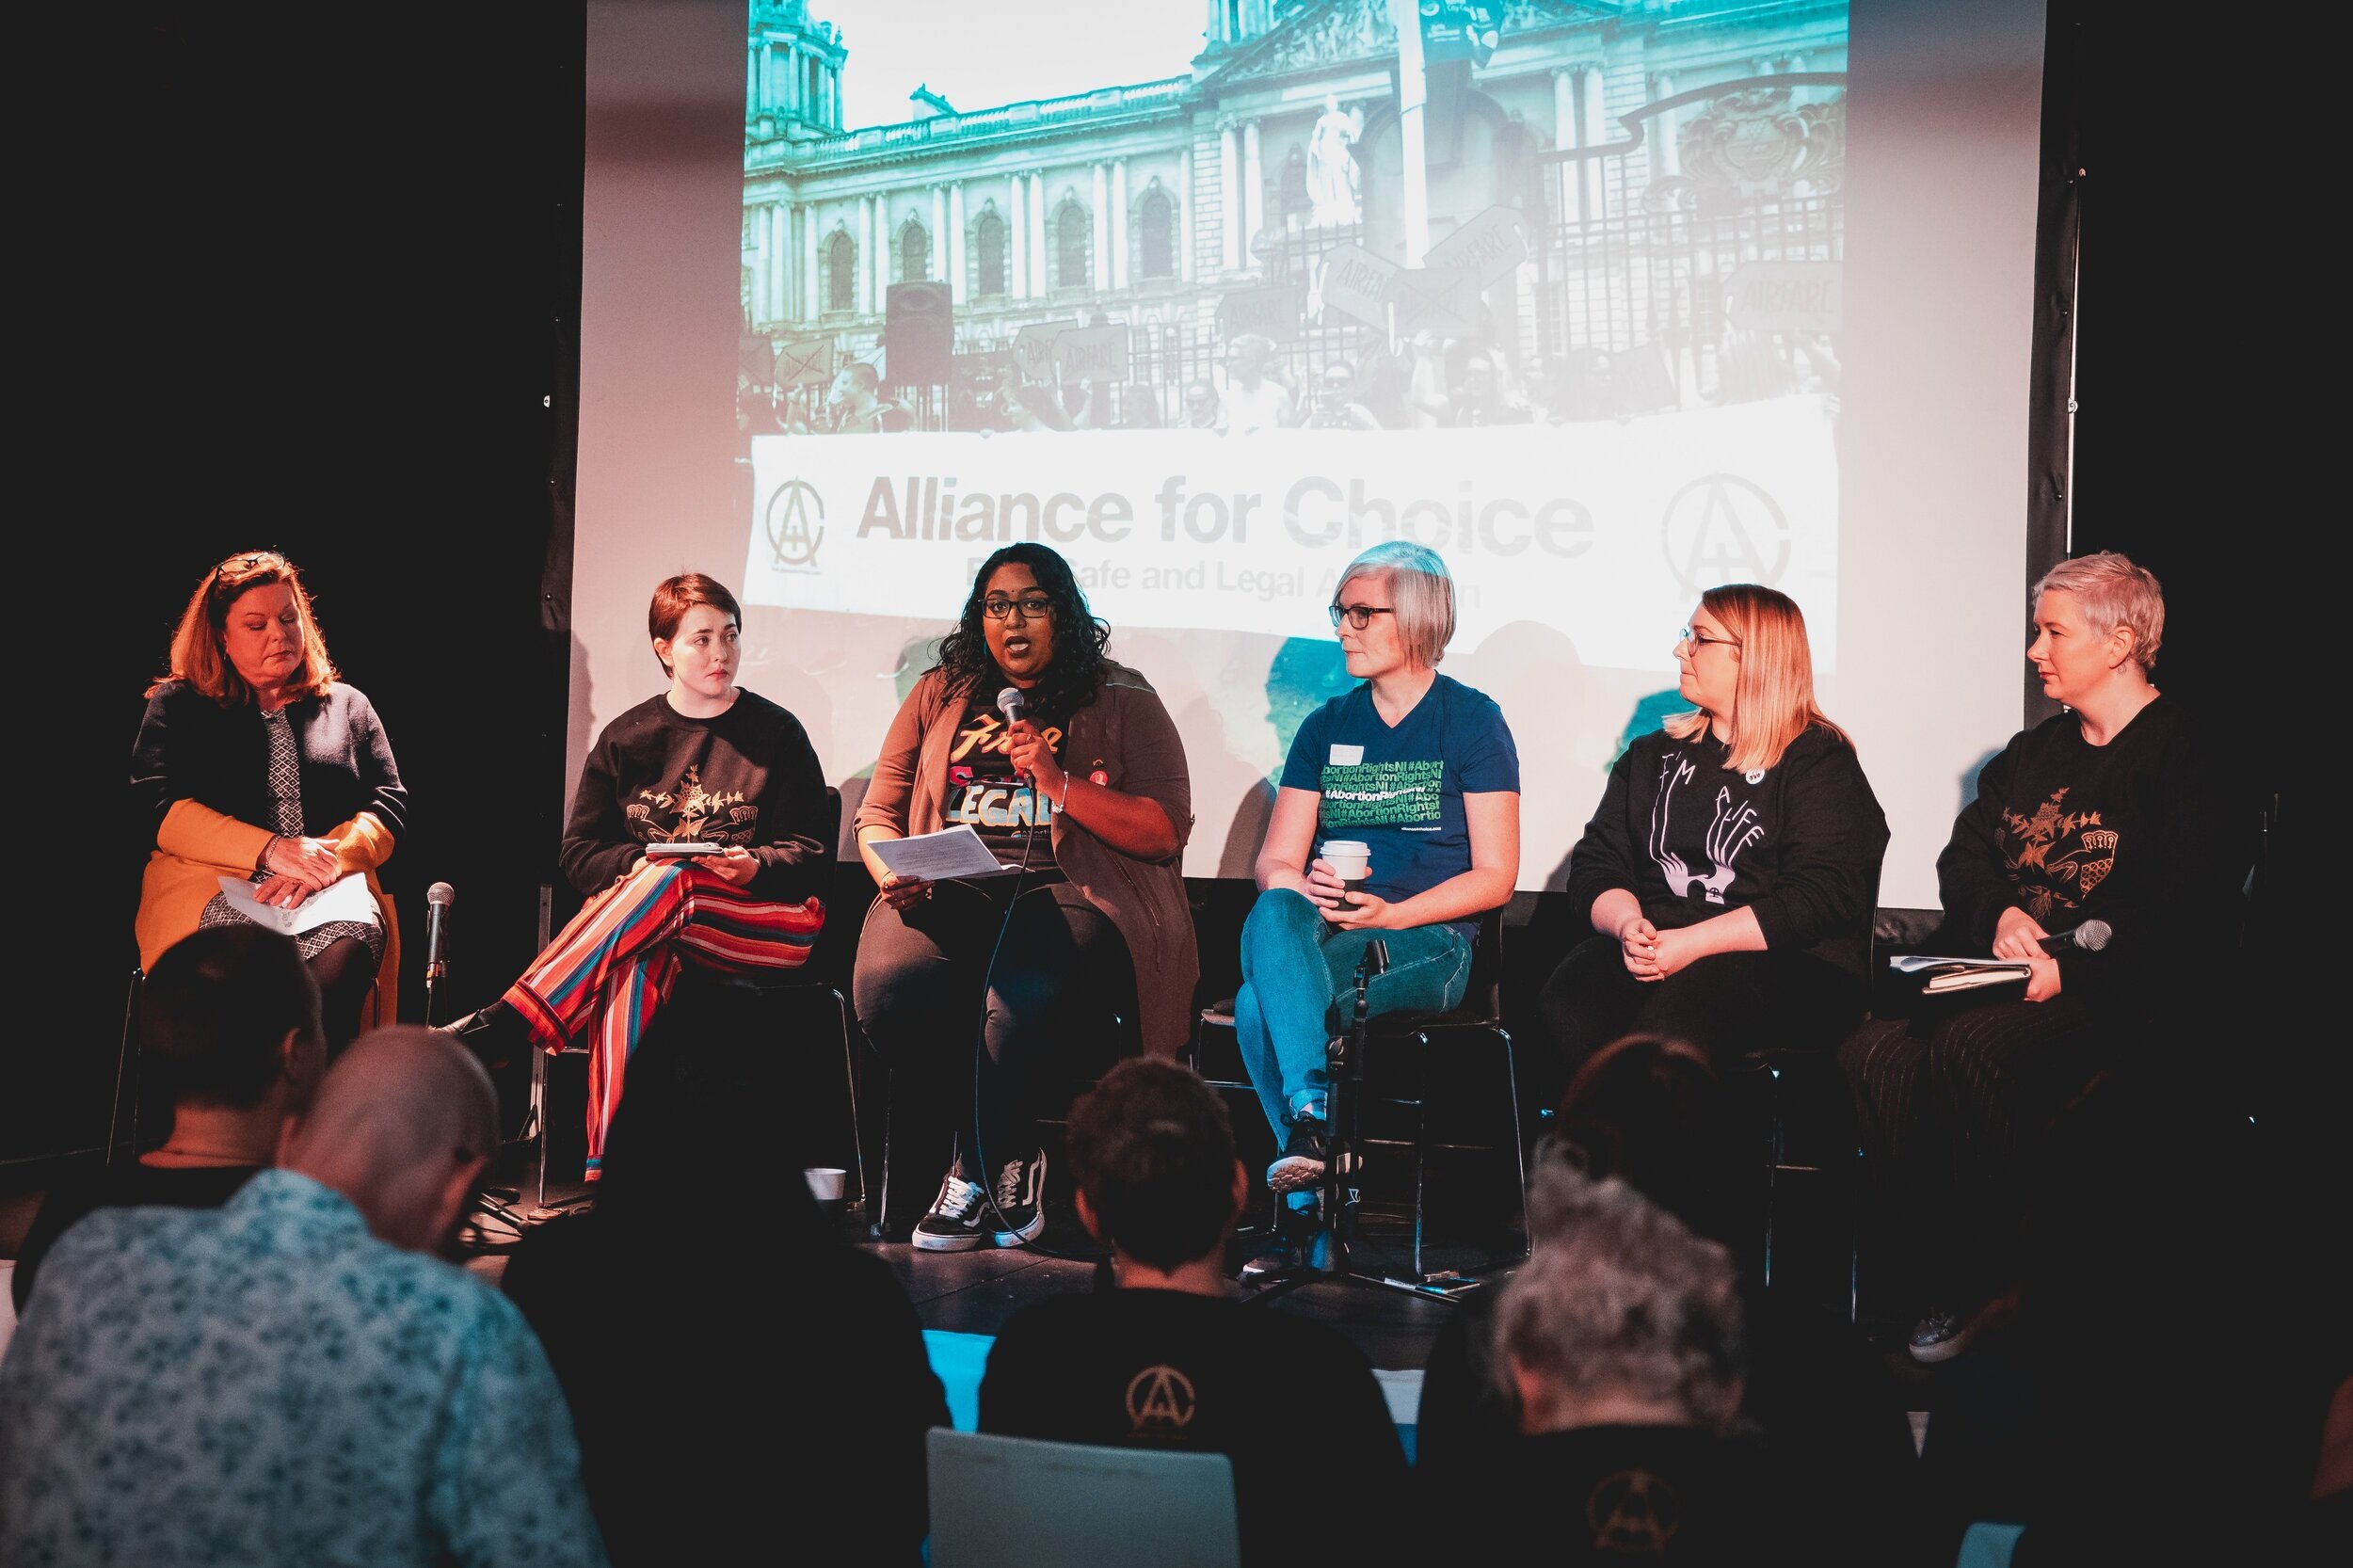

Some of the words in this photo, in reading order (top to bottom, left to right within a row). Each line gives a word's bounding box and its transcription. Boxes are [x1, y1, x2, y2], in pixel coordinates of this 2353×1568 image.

[1740, 280, 1835, 316] AIRFARE
[856, 475, 1134, 543] Alliance
[1155, 474, 1262, 544] for
[1283, 475, 1596, 557] Choice
[1142, 560, 1205, 590] and
[1217, 561, 1305, 602] Legal
